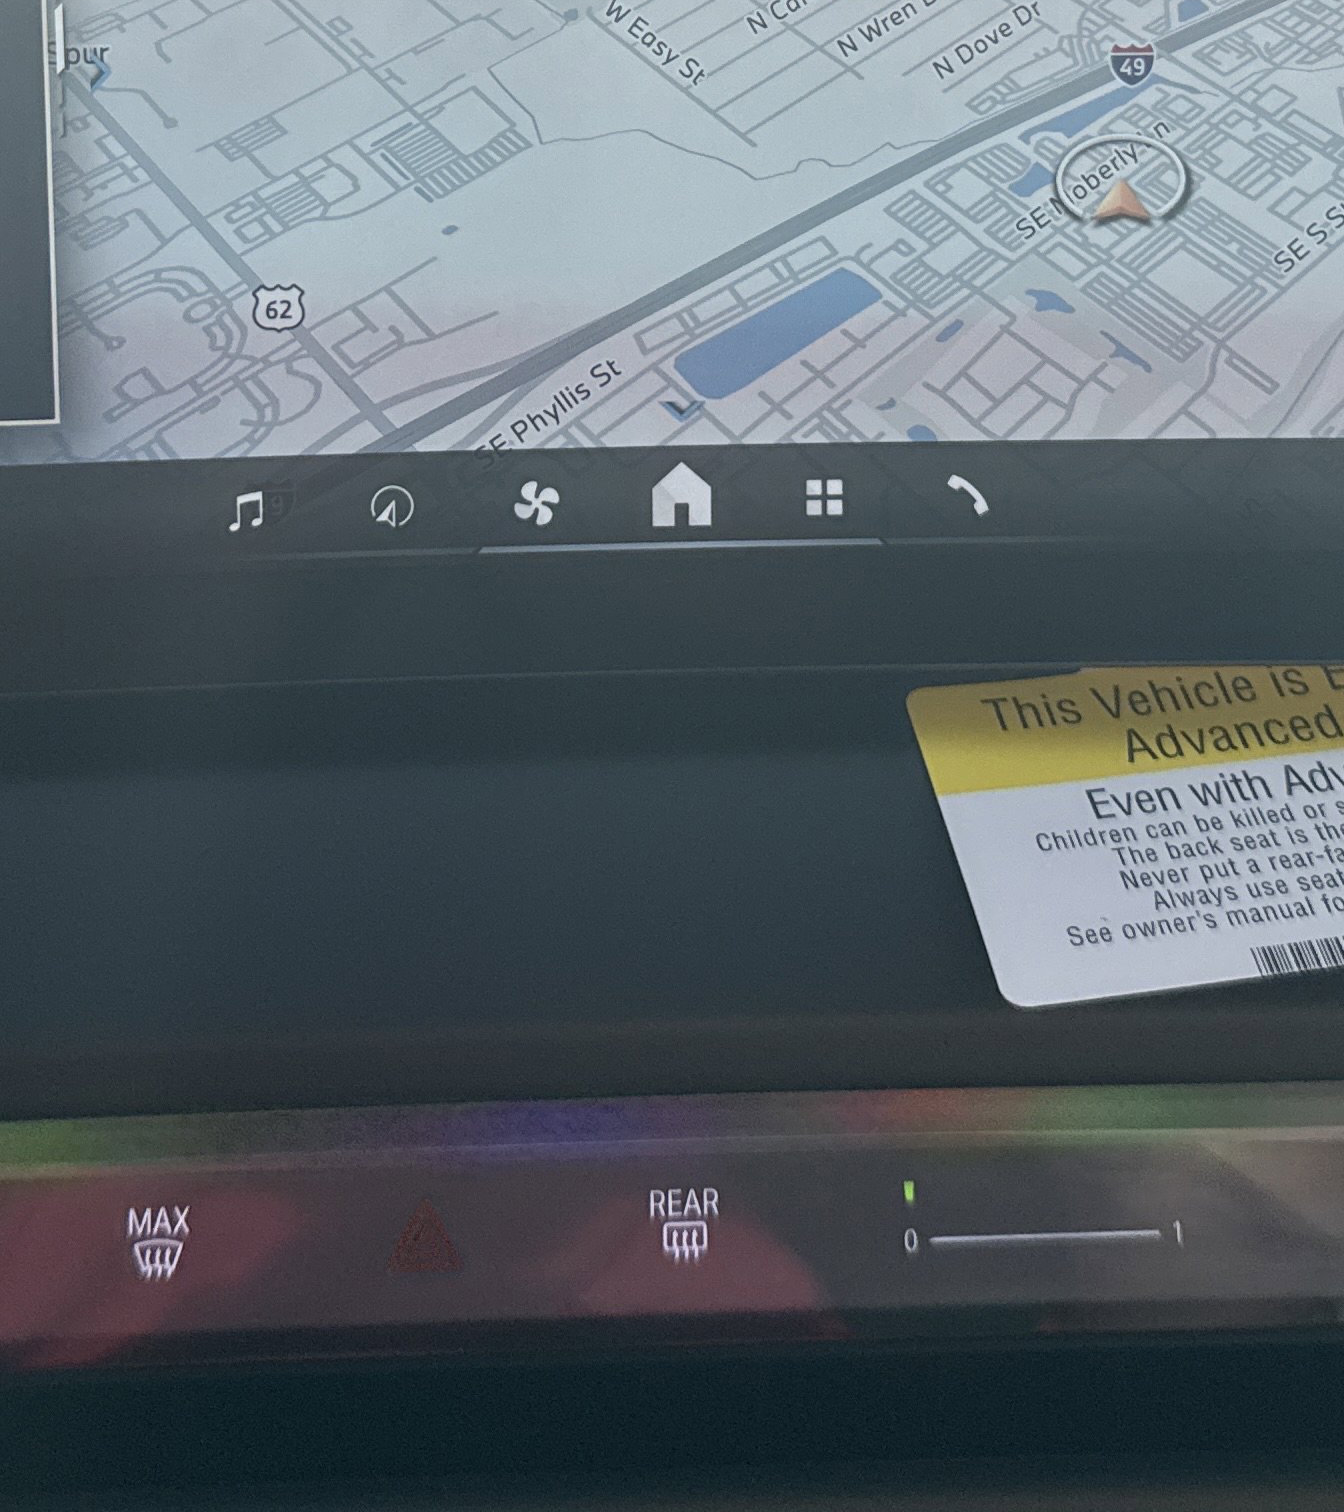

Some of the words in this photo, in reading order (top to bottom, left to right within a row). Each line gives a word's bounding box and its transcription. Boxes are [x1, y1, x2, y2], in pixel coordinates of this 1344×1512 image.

[746, 11, 768, 36] N
[835, 35, 858, 59] N
[856, 0, 918, 48] Wren
[932, 57, 956, 81] N
[953, 18, 1015, 68] Dove
[1013, 0, 1042, 27] Dr
[626, 17, 682, 69] Easy
[678, 56, 707, 87] St
[1119, 56, 1147, 77] 49
[1015, 205, 1052, 240] SE
[1273, 238, 1312, 275] SE
[1306, 220, 1330, 247] S
[264, 300, 294, 322] 62
[510, 382, 592, 444] Phyllis
[589, 359, 623, 388] St
[981, 693, 1084, 733] This
[1090, 670, 1258, 722] Vehicle
[1268, 665, 1310, 698] is
[1125, 703, 1344, 765] Advanced
[1085, 785, 1183, 821] Even
[1188, 769, 1275, 805] with
[1035, 823, 1138, 854] Children
[1145, 820, 1189, 841] can
[1193, 814, 1224, 834] be
[1232, 803, 1297, 829] killed
[1303, 800, 1328, 819] or
[1111, 843, 1158, 868] The
[1166, 832, 1225, 860] back
[1229, 828, 1283, 853] seat
[1287, 823, 1310, 846] is
[1118, 864, 1191, 893] Never
[1198, 856, 1242, 885] put
[1246, 858, 1263, 875] a
[1152, 882, 1241, 914] Always
[1246, 876, 1289, 900] use
[1065, 924, 1115, 948] See
[1121, 910, 1219, 942] owner's
[1226, 896, 1317, 929] manual
[127, 1205, 191, 1236] MAX
[648, 1188, 721, 1218] REAR
[904, 1228, 919, 1253] 0
[1172, 1220, 1184, 1247] 1
